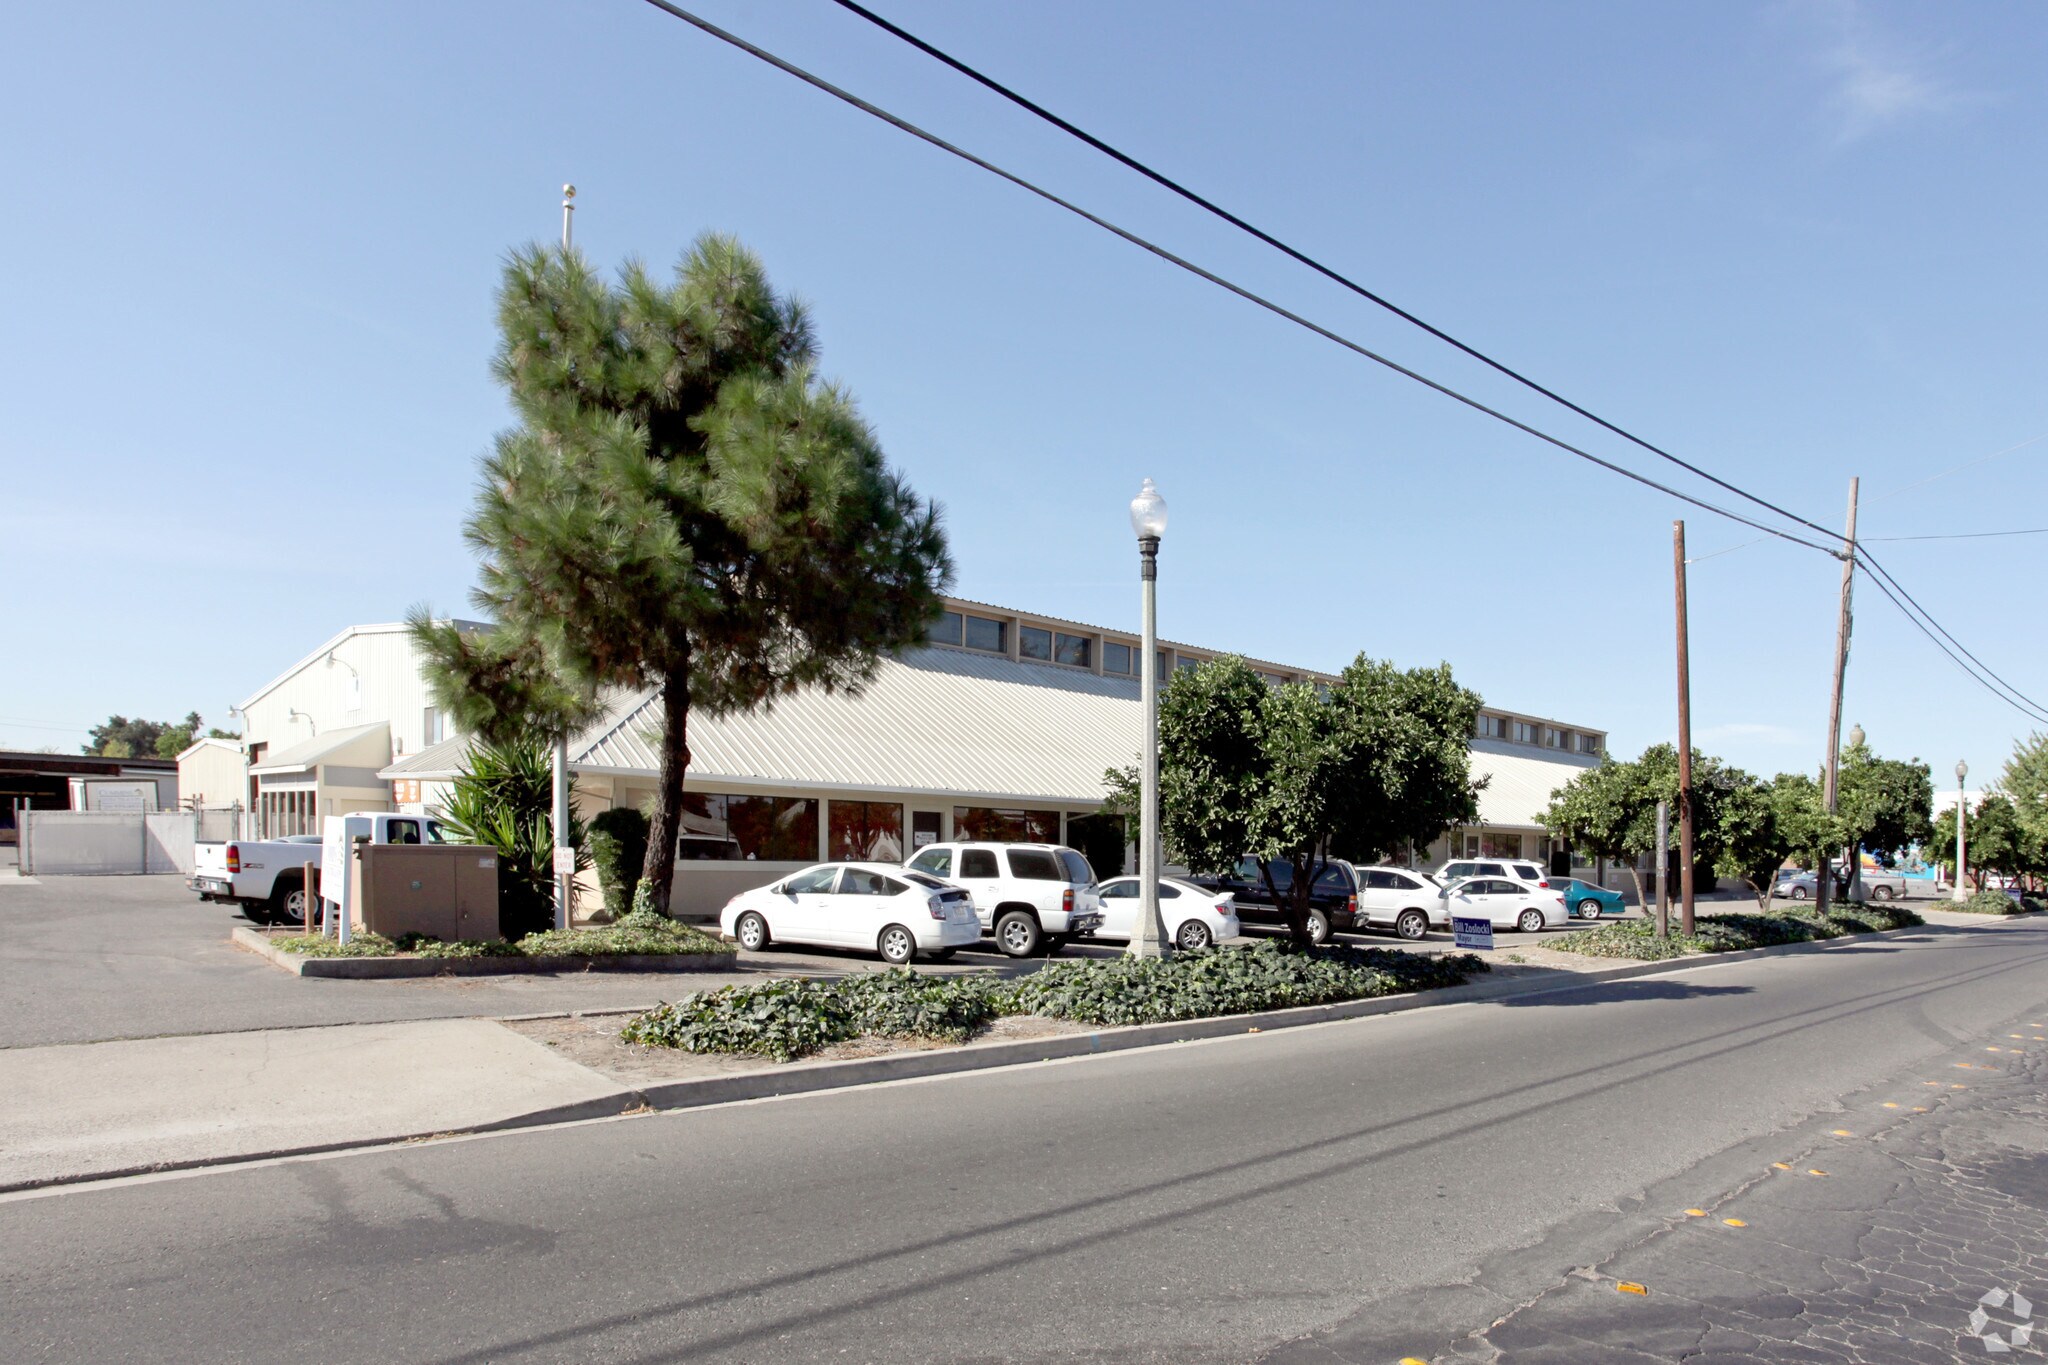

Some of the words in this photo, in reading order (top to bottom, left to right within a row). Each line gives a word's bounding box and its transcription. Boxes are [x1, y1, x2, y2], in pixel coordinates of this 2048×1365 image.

[556, 861, 571, 869] ENTER
[1454, 921, 1465, 933] Bill
[1457, 933, 1472, 944] Mayor
